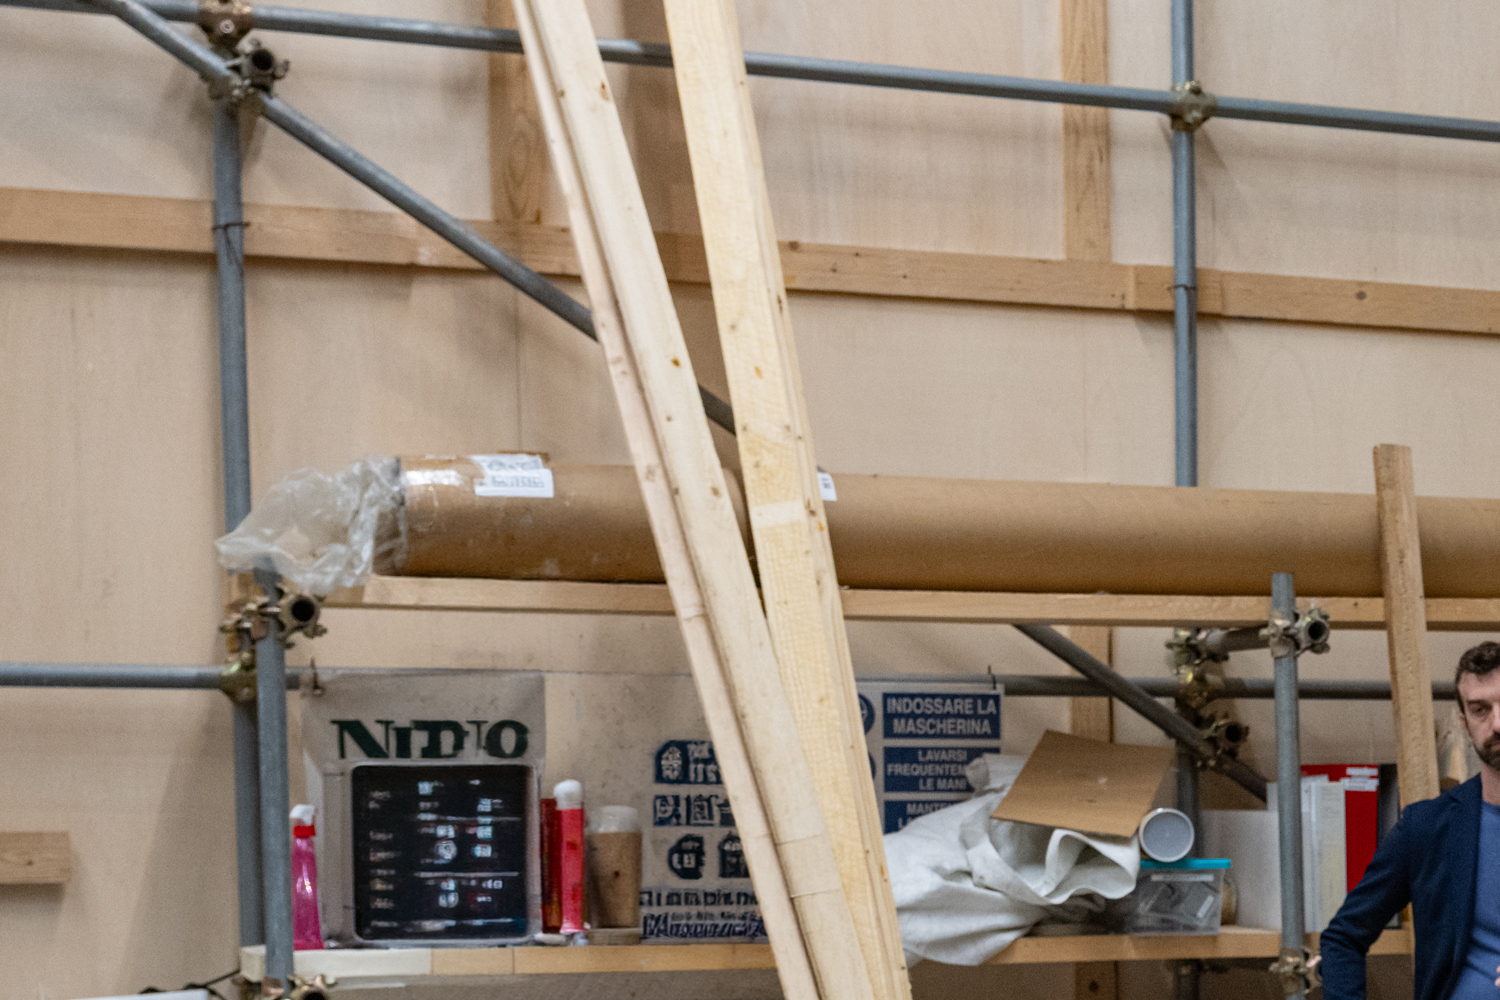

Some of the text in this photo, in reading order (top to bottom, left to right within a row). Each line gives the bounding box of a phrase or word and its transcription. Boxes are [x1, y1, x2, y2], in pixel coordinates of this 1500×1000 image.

[886, 697, 997, 715] INDOSSARE LA
[892, 717, 992, 735] MASCHERINA
[917, 749, 968, 762] LAVARSI
[918, 778, 935, 791] LE
